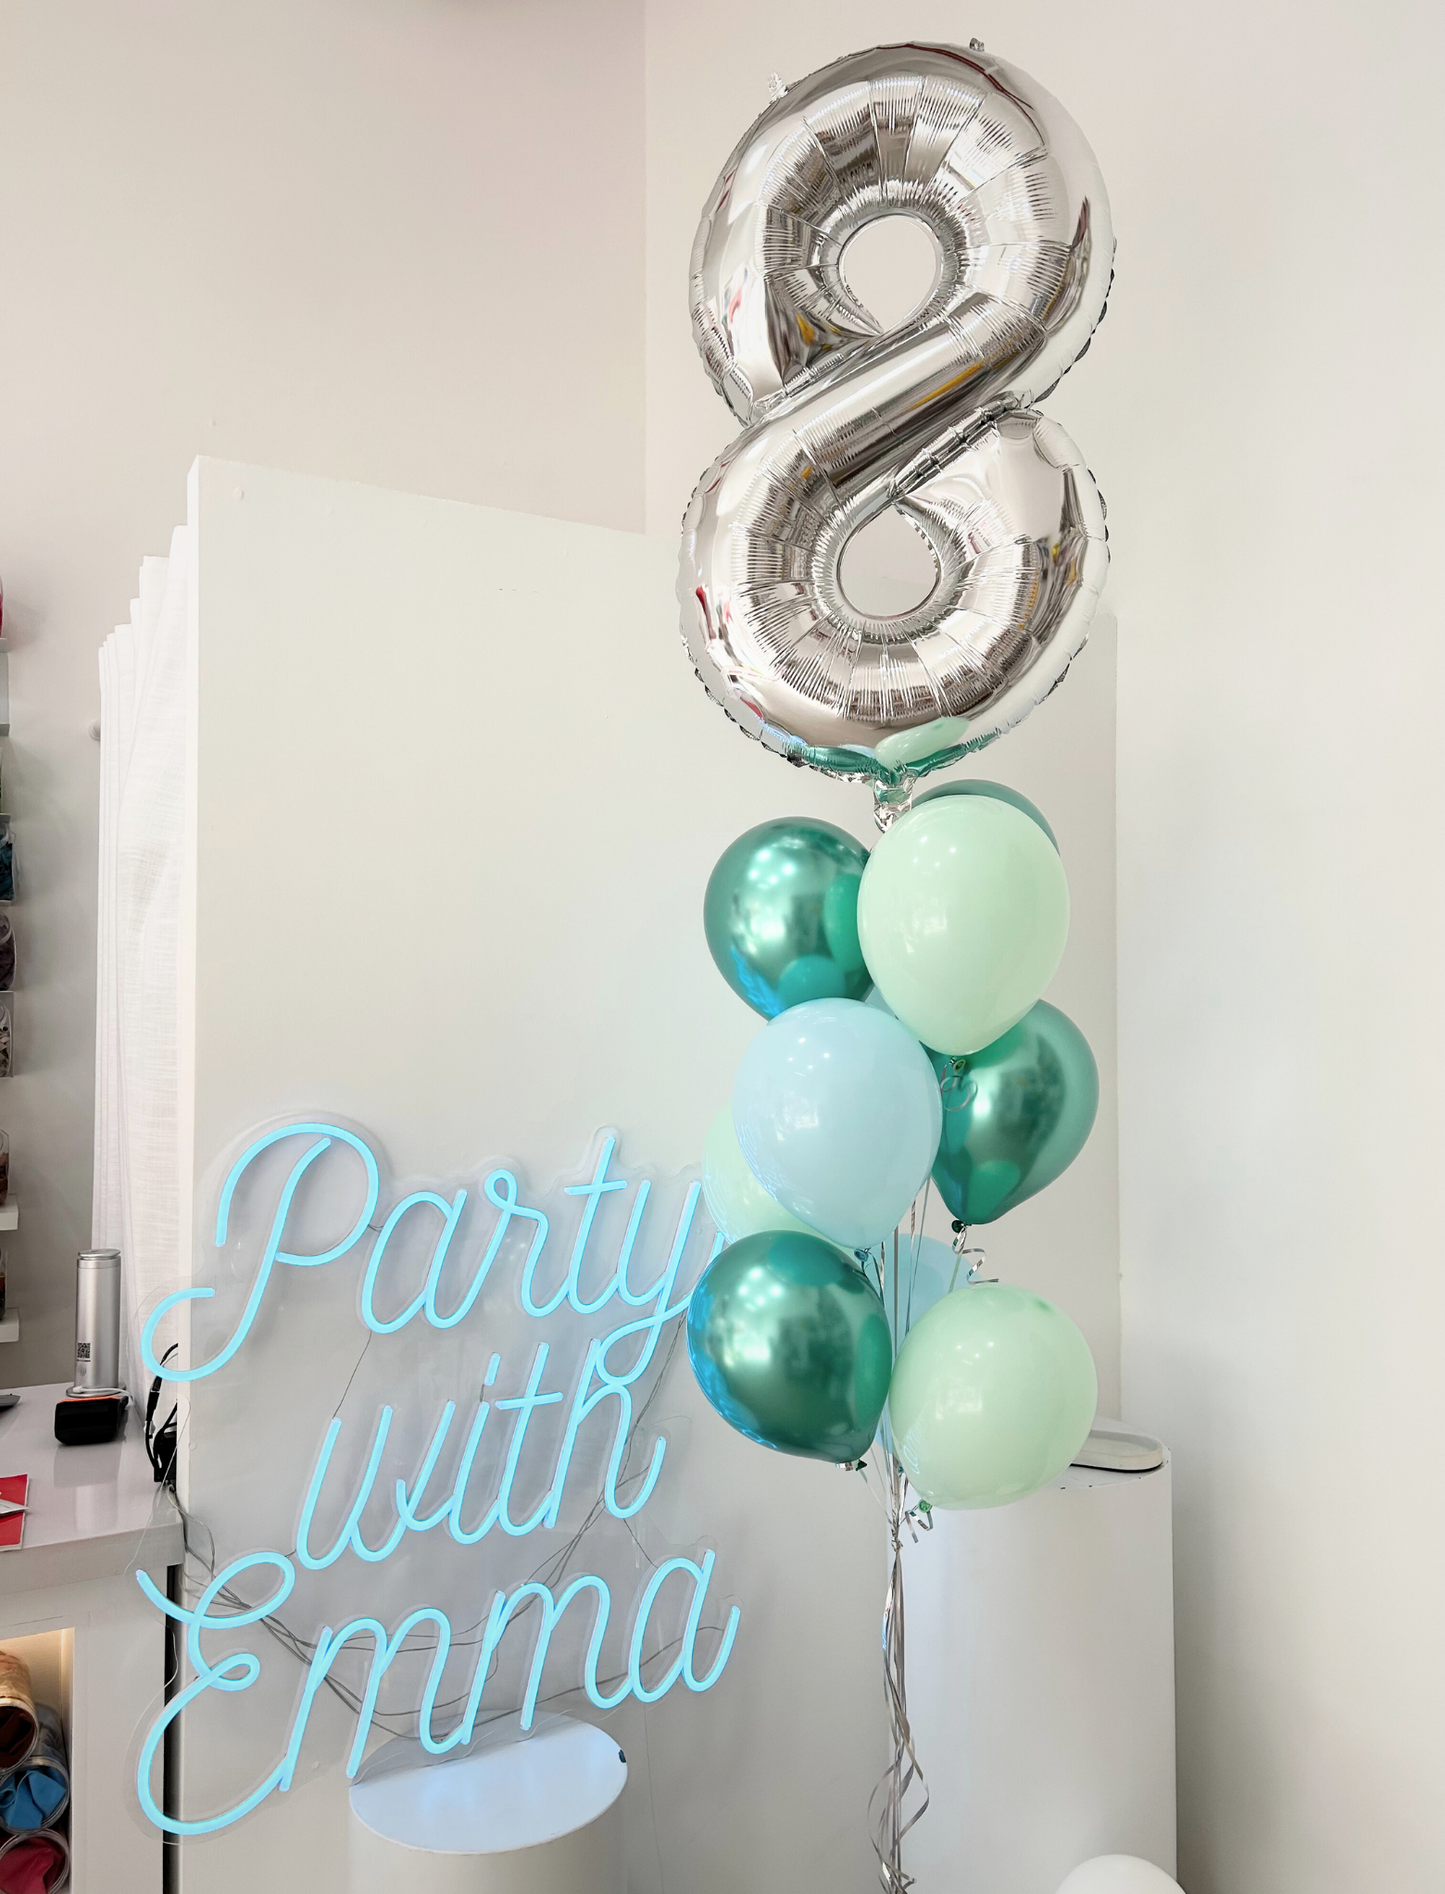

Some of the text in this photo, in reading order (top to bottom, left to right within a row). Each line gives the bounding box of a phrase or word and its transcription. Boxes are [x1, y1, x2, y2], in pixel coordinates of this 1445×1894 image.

[680, 42, 1116, 782] 8
[140, 1123, 724, 1382] Party
[295, 1339, 667, 1570] with
[136, 1549, 741, 1836] Emma
